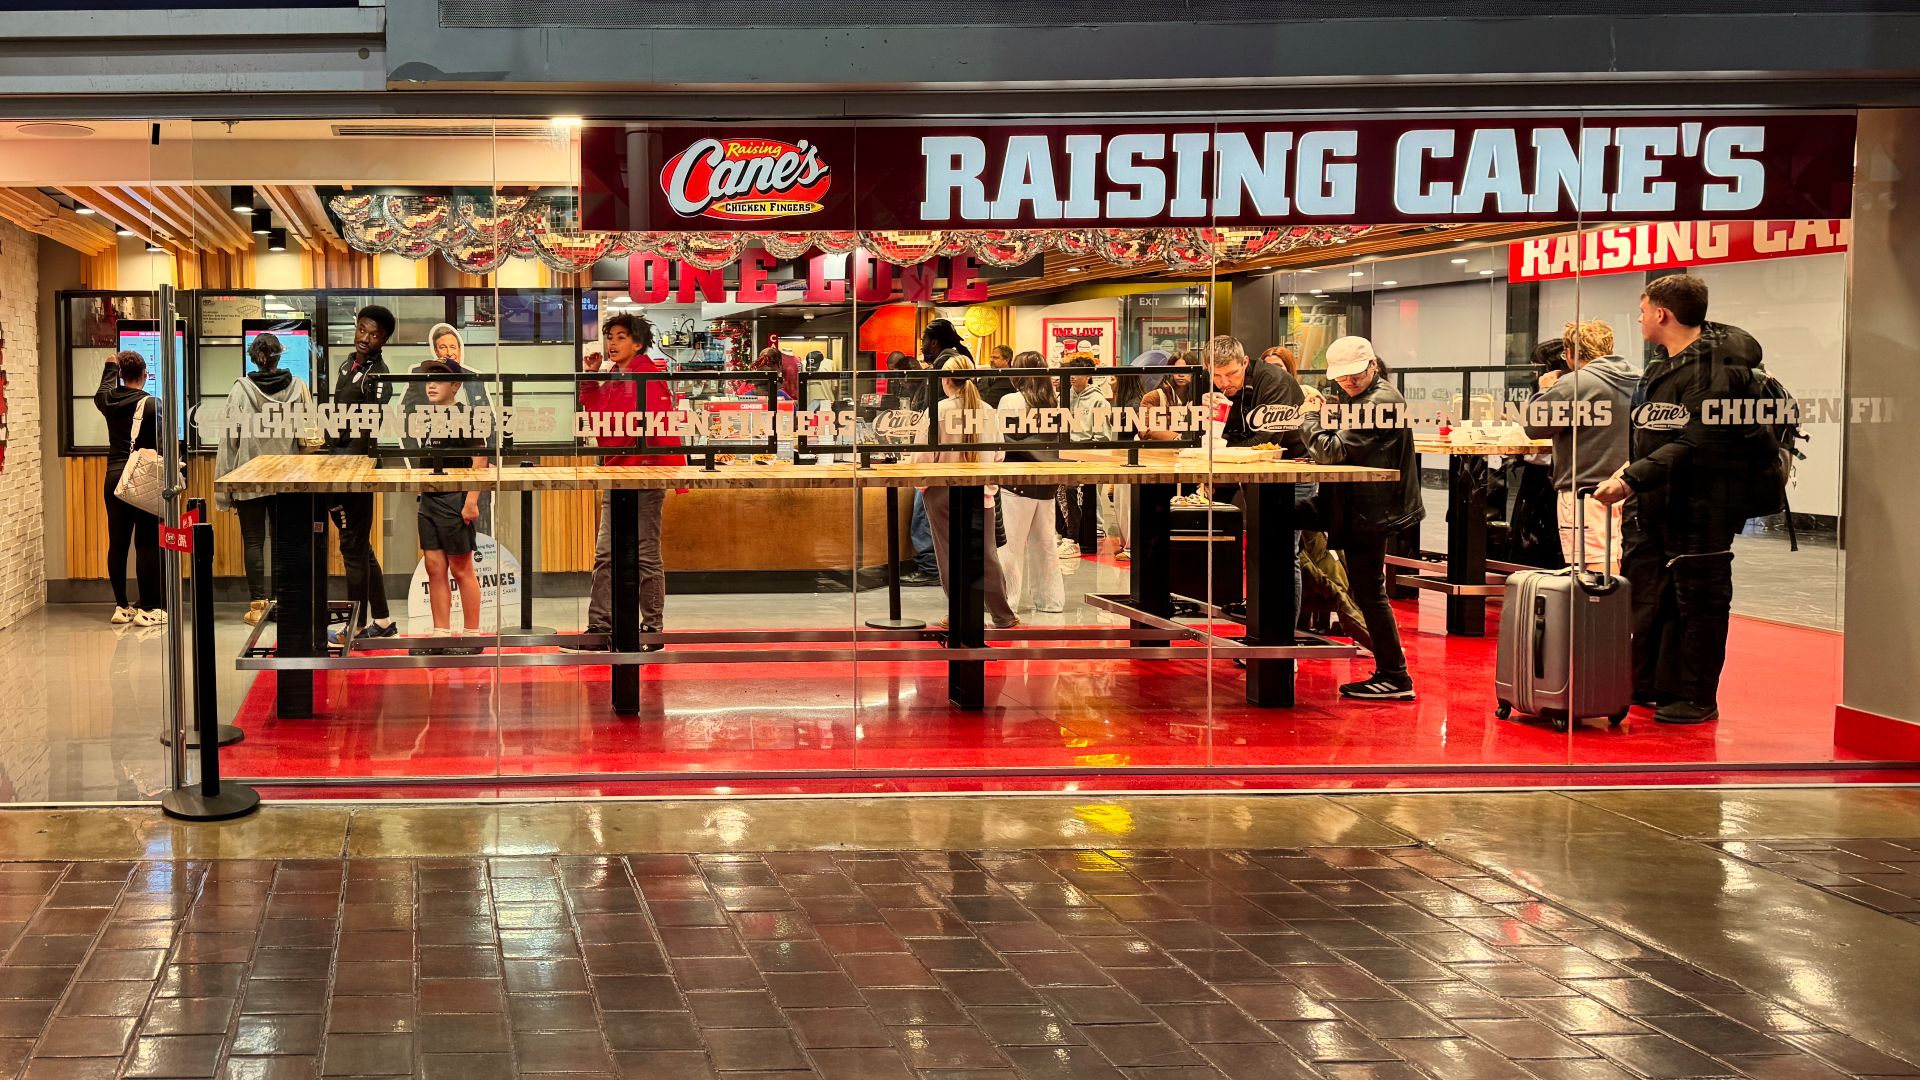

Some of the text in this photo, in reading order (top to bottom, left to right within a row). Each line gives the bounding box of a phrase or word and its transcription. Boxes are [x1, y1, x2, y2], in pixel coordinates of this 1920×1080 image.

[726, 142, 782, 157] Raising
[669, 138, 829, 213] Cane's
[920, 122, 1765, 221] RAISING CANE'S
[725, 202, 811, 212] CHICKEN FINGERS
[1521, 221, 1729, 277] RAISING
[627, 245, 989, 304] ONE LOVE
[1139, 297, 1160, 306] EXIT
[1053, 328, 1104, 337] ONE LOVE
[574, 411, 708, 437] CHICKEN
[718, 410, 856, 436] FINGERS
[875, 402, 1302, 434] Cane' CHICKEN FINGER Cane's
[1633, 402, 1689, 427] Cane's
[1702, 398, 1841, 425] CHICKEN
[477, 572, 516, 589] AVES
